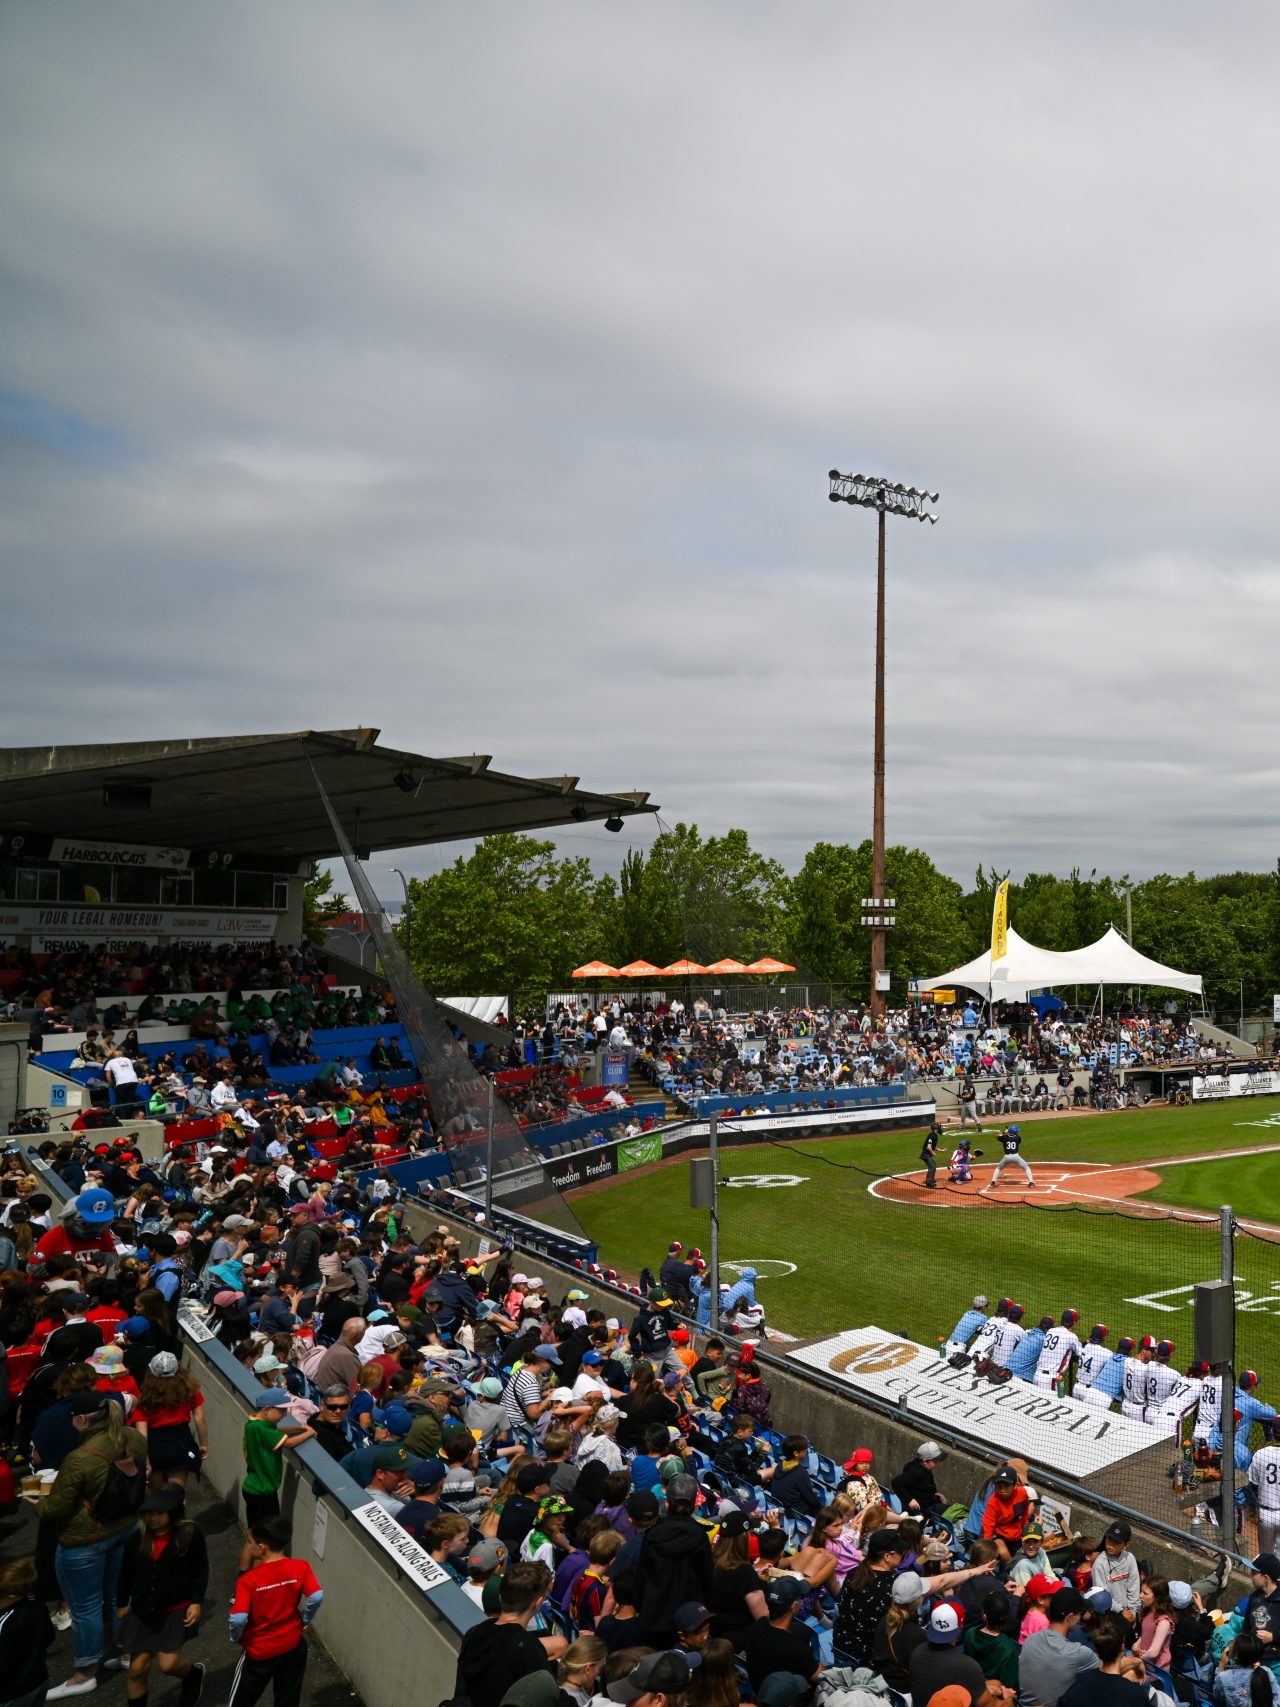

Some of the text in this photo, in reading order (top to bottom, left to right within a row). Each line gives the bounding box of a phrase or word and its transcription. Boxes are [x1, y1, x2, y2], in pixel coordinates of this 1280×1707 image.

[62, 848, 146, 864] HARBOURCATS
[38, 910, 69, 925] YOUR
[71, 911, 105, 925] LEGAL
[109, 912, 163, 926] HOMERUN!
[53, 1089, 65, 1099] 10
[1006, 1142, 1016, 1150] 30
[586, 1162, 612, 1176] Freedom
[552, 1172, 580, 1187] Freedom
[994, 1329, 1005, 1347] 51
[1043, 1333, 1060, 1350] 39
[1078, 1353, 1093, 1373] 54
[1126, 1373, 1132, 1390] 6
[1149, 1378, 1157, 1395] 3
[885, 1377, 997, 1426] CAPITAL
[917, 1361, 1126, 1441] WESTURBAN
[1202, 1384, 1216, 1404] 38
[363, 1505, 444, 1582] NO STANDING ALONG RAILS
